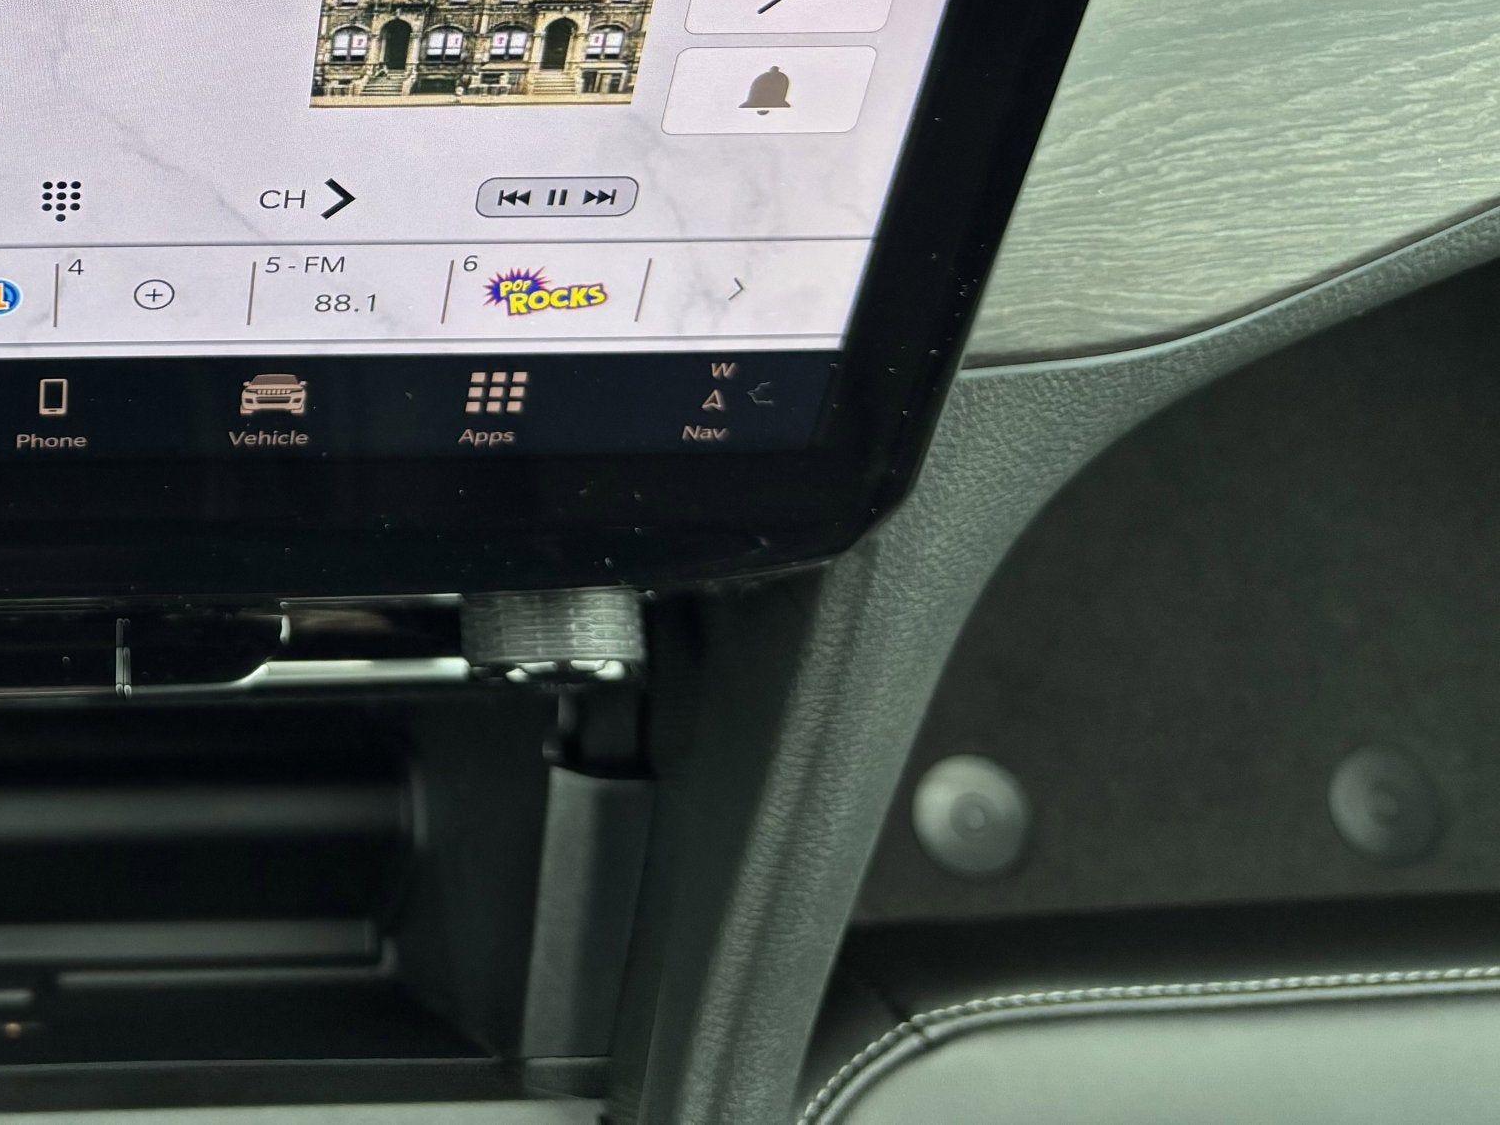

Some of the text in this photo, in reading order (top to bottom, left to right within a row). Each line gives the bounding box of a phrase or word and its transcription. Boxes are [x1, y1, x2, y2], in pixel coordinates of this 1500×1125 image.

[258, 189, 307, 211] CH
[67, 258, 85, 277] 4
[264, 256, 282, 275] 5
[303, 255, 347, 274] FM
[462, 254, 479, 273] 6
[498, 278, 533, 298] POP
[314, 293, 378, 314] 88.1
[507, 282, 608, 317] ROCKS
[711, 362, 738, 379] W
[15, 431, 88, 450] Phone
[228, 429, 309, 449] Vehicle
[458, 427, 516, 447] Apps
[681, 424, 729, 443] Nav
